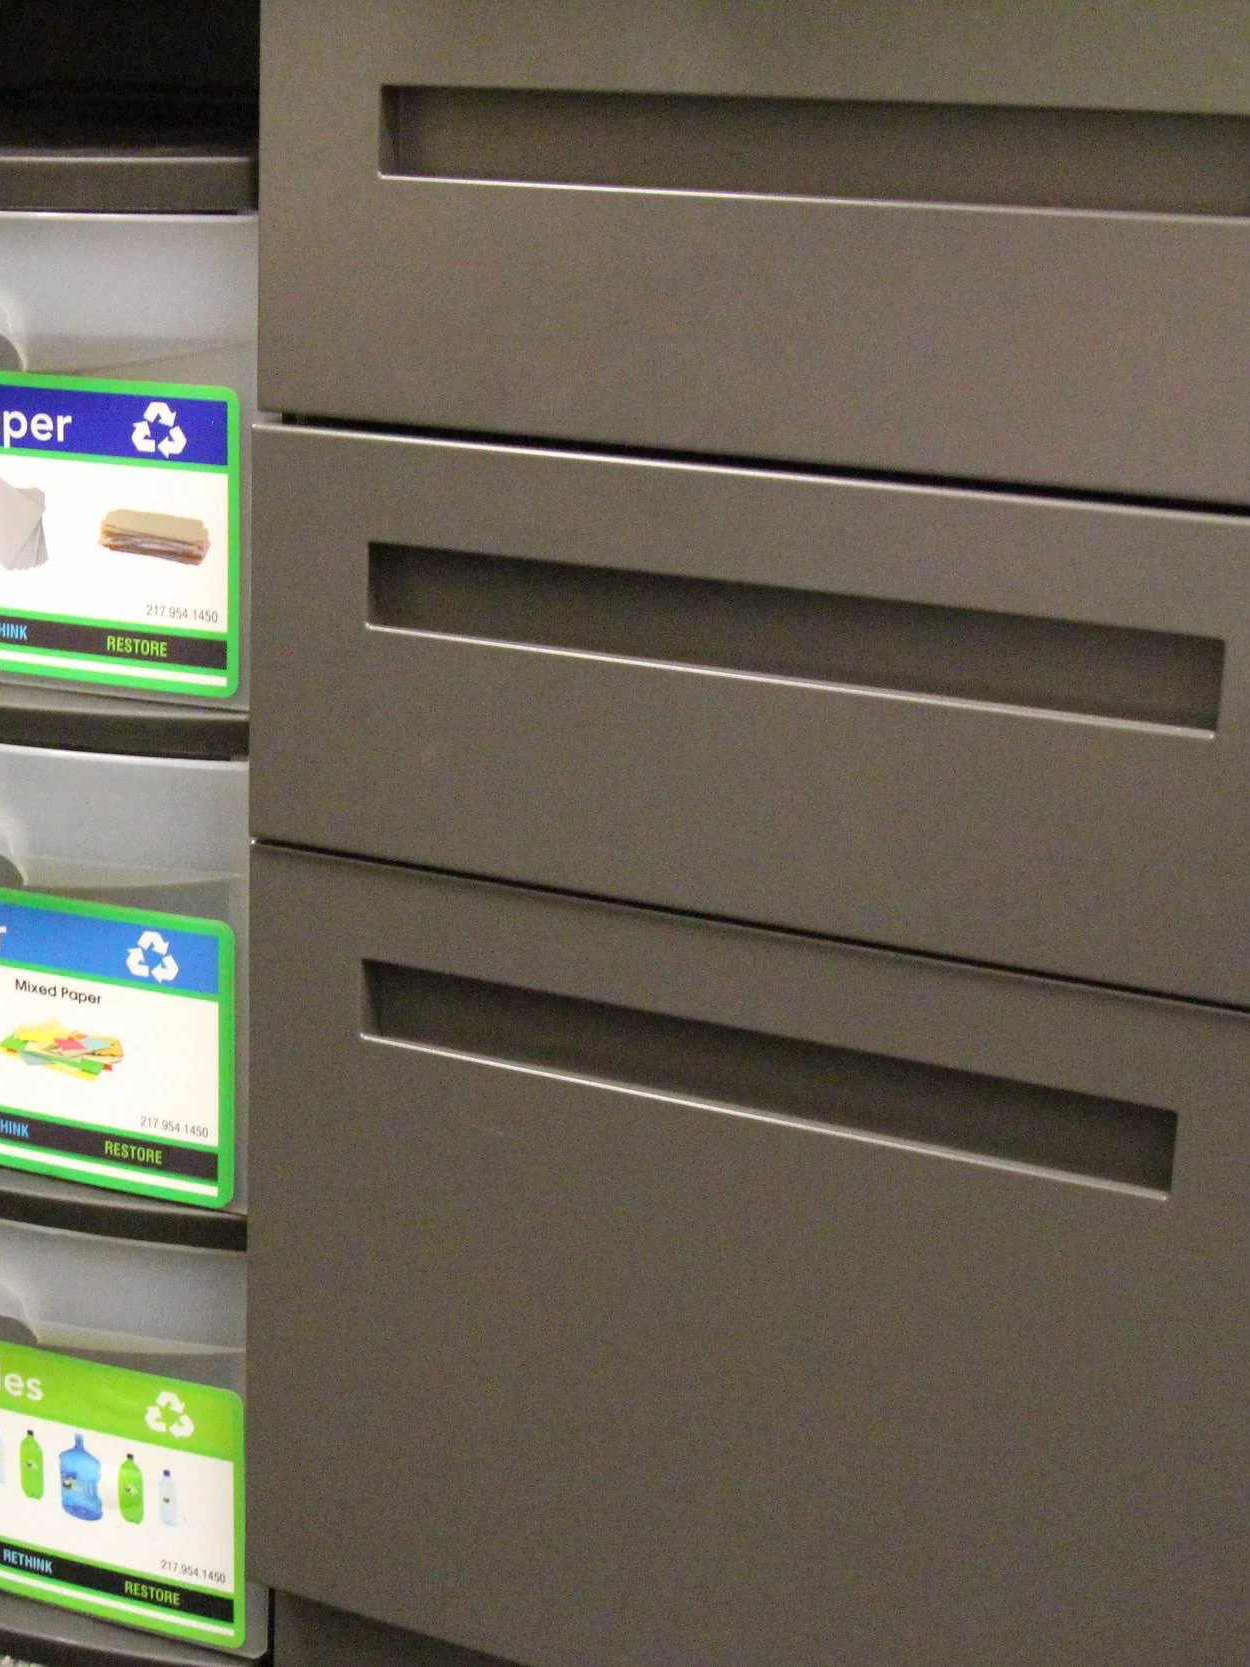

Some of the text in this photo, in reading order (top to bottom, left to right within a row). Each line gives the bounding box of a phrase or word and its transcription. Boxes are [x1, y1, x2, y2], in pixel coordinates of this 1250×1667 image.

[146, 604, 219, 623] 217.954.1450
[106, 635, 168, 657] RESTORE
[15, 978, 102, 1005] Mixed Paper
[140, 1115, 209, 1138] 217.954.1450
[104, 1140, 163, 1165] RESTORE
[3, 1548, 53, 1574] RETHINK
[124, 1580, 181, 1606] RESTORE
